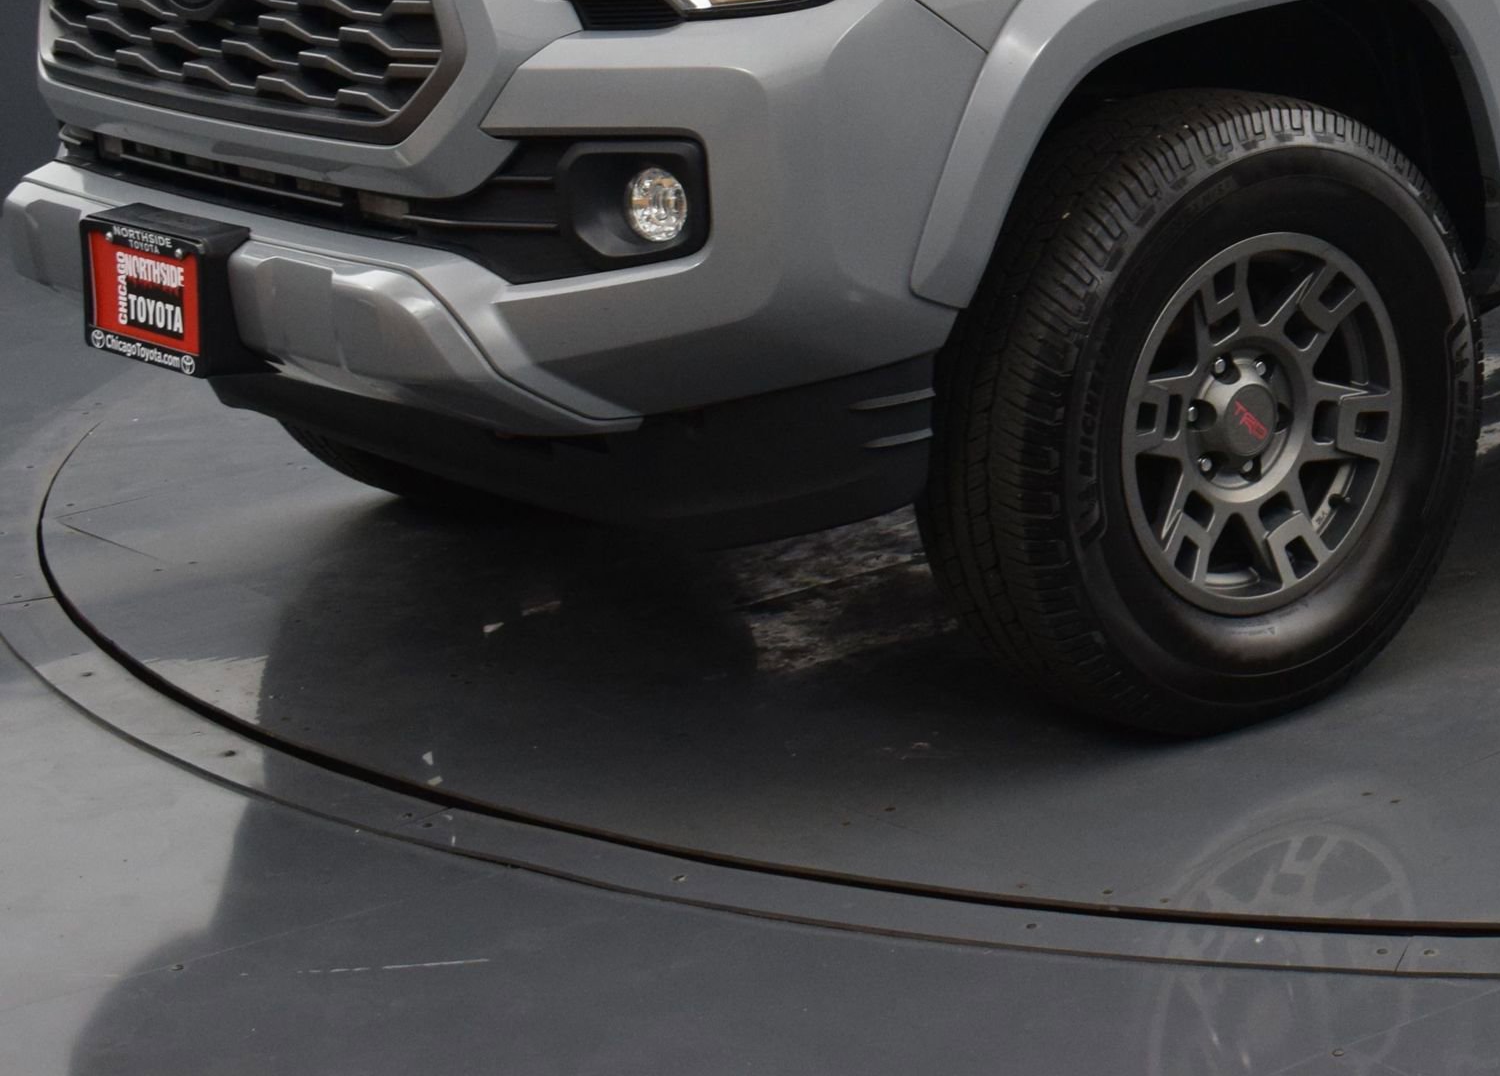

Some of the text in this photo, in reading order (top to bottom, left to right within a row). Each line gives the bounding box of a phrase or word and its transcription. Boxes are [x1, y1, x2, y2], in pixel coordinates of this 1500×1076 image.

[112, 225, 173, 248] NORTHSIDE
[128, 239, 160, 254] TOYOTA
[116, 251, 128, 325] CHICAGO
[125, 254, 184, 288] NORTHSIDE
[128, 294, 184, 334] TOYOTA
[105, 334, 181, 368] ChicagoToyota.com
[1233, 399, 1269, 441] TRD
